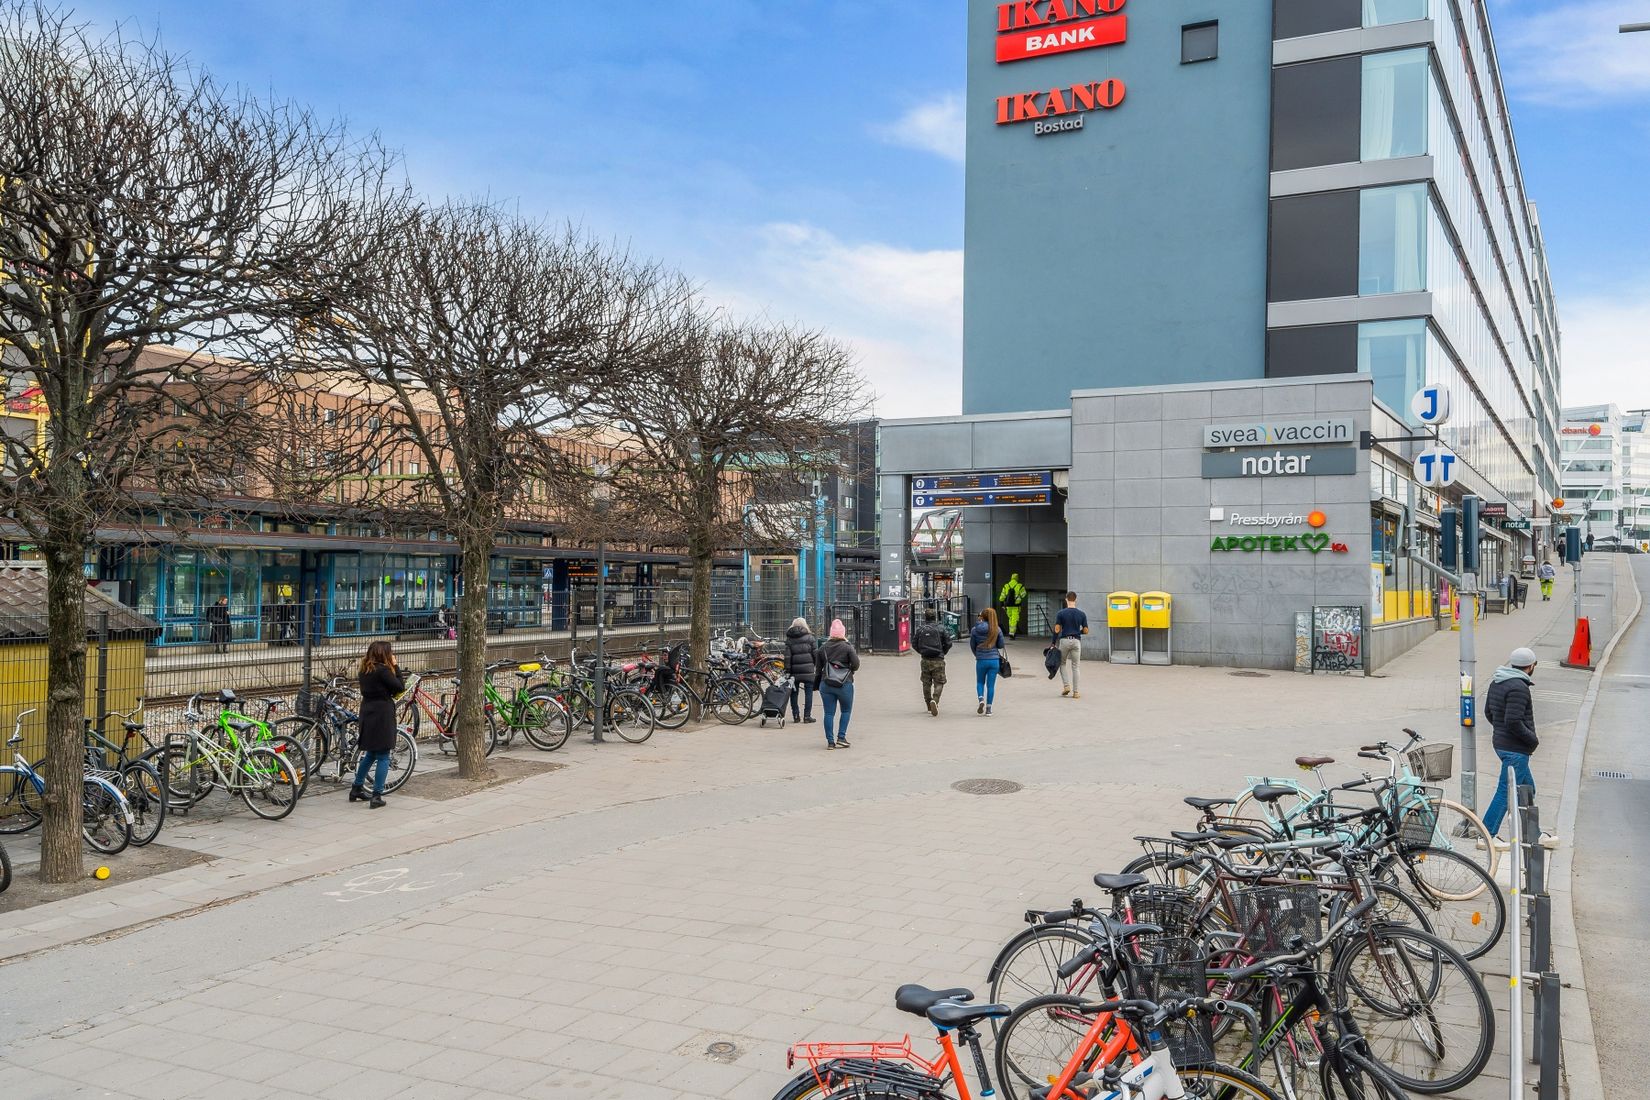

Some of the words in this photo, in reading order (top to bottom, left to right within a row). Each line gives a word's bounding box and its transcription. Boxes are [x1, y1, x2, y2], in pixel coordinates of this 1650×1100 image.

[1026, 26, 1095, 51] BANK
[995, 78, 1126, 124] IKANO
[1034, 114, 1084, 134] Bostad
[1420, 389, 1437, 420] J
[1210, 428, 1258, 443] svea
[1273, 420, 1347, 440] vaccin
[1242, 451, 1311, 475] notar
[1419, 454, 1436, 482] T
[1440, 454, 1455, 482] T
[1230, 512, 1302, 528] Pressbyrån
[1505, 519, 1526, 529] notar
[1211, 535, 1298, 552] APOTEK
[1331, 542, 1348, 552] ICA
